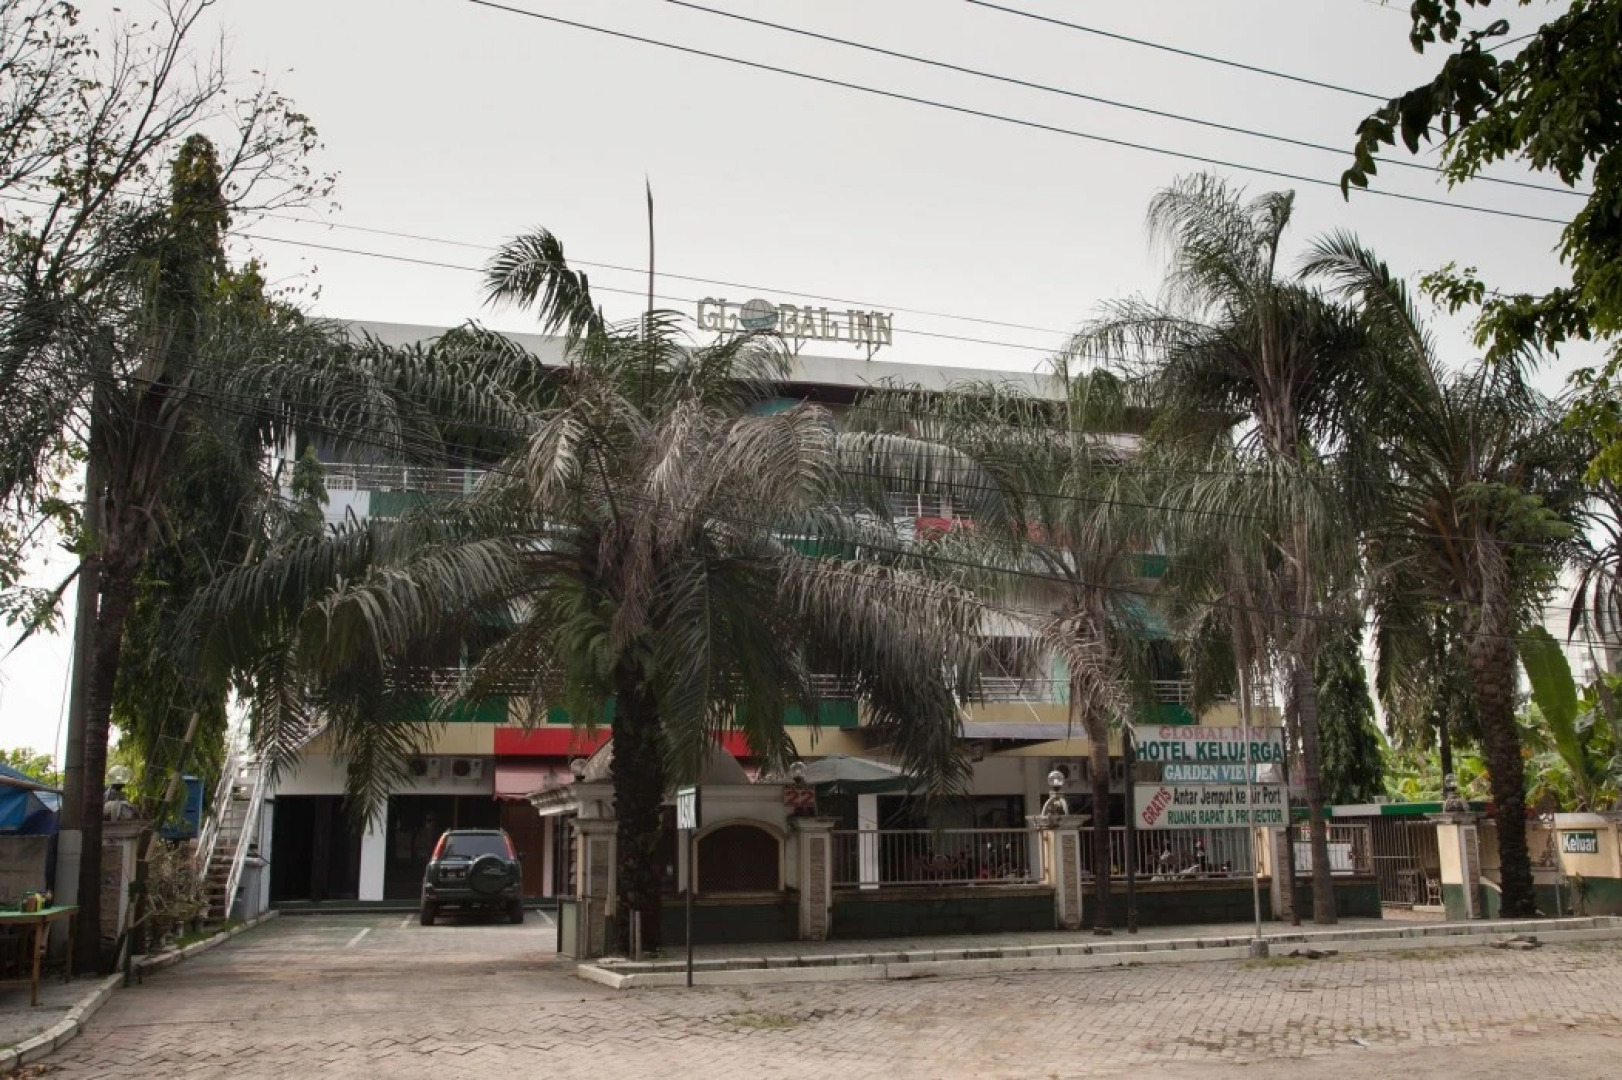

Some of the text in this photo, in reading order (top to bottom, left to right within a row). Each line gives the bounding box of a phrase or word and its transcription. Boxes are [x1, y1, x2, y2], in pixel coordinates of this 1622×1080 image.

[846, 309, 894, 348] INN
[1158, 726, 1228, 740] GLOBAL
[1136, 741, 1191, 760] HOTEL
[1164, 764, 1218, 780] GARDEN
[785, 790, 815, 806] 22
[1141, 786, 1172, 826] GRATIS
[1173, 787, 1198, 804] Antar
[1200, 787, 1234, 808] Jemput
[1235, 786, 1246, 804] ke
[1262, 786, 1281, 804] Port
[1167, 809, 1197, 824] RUANG
[1198, 809, 1225, 824] RAPAT
[1227, 809, 1234, 823] &
[1563, 833, 1597, 852] Keluar
